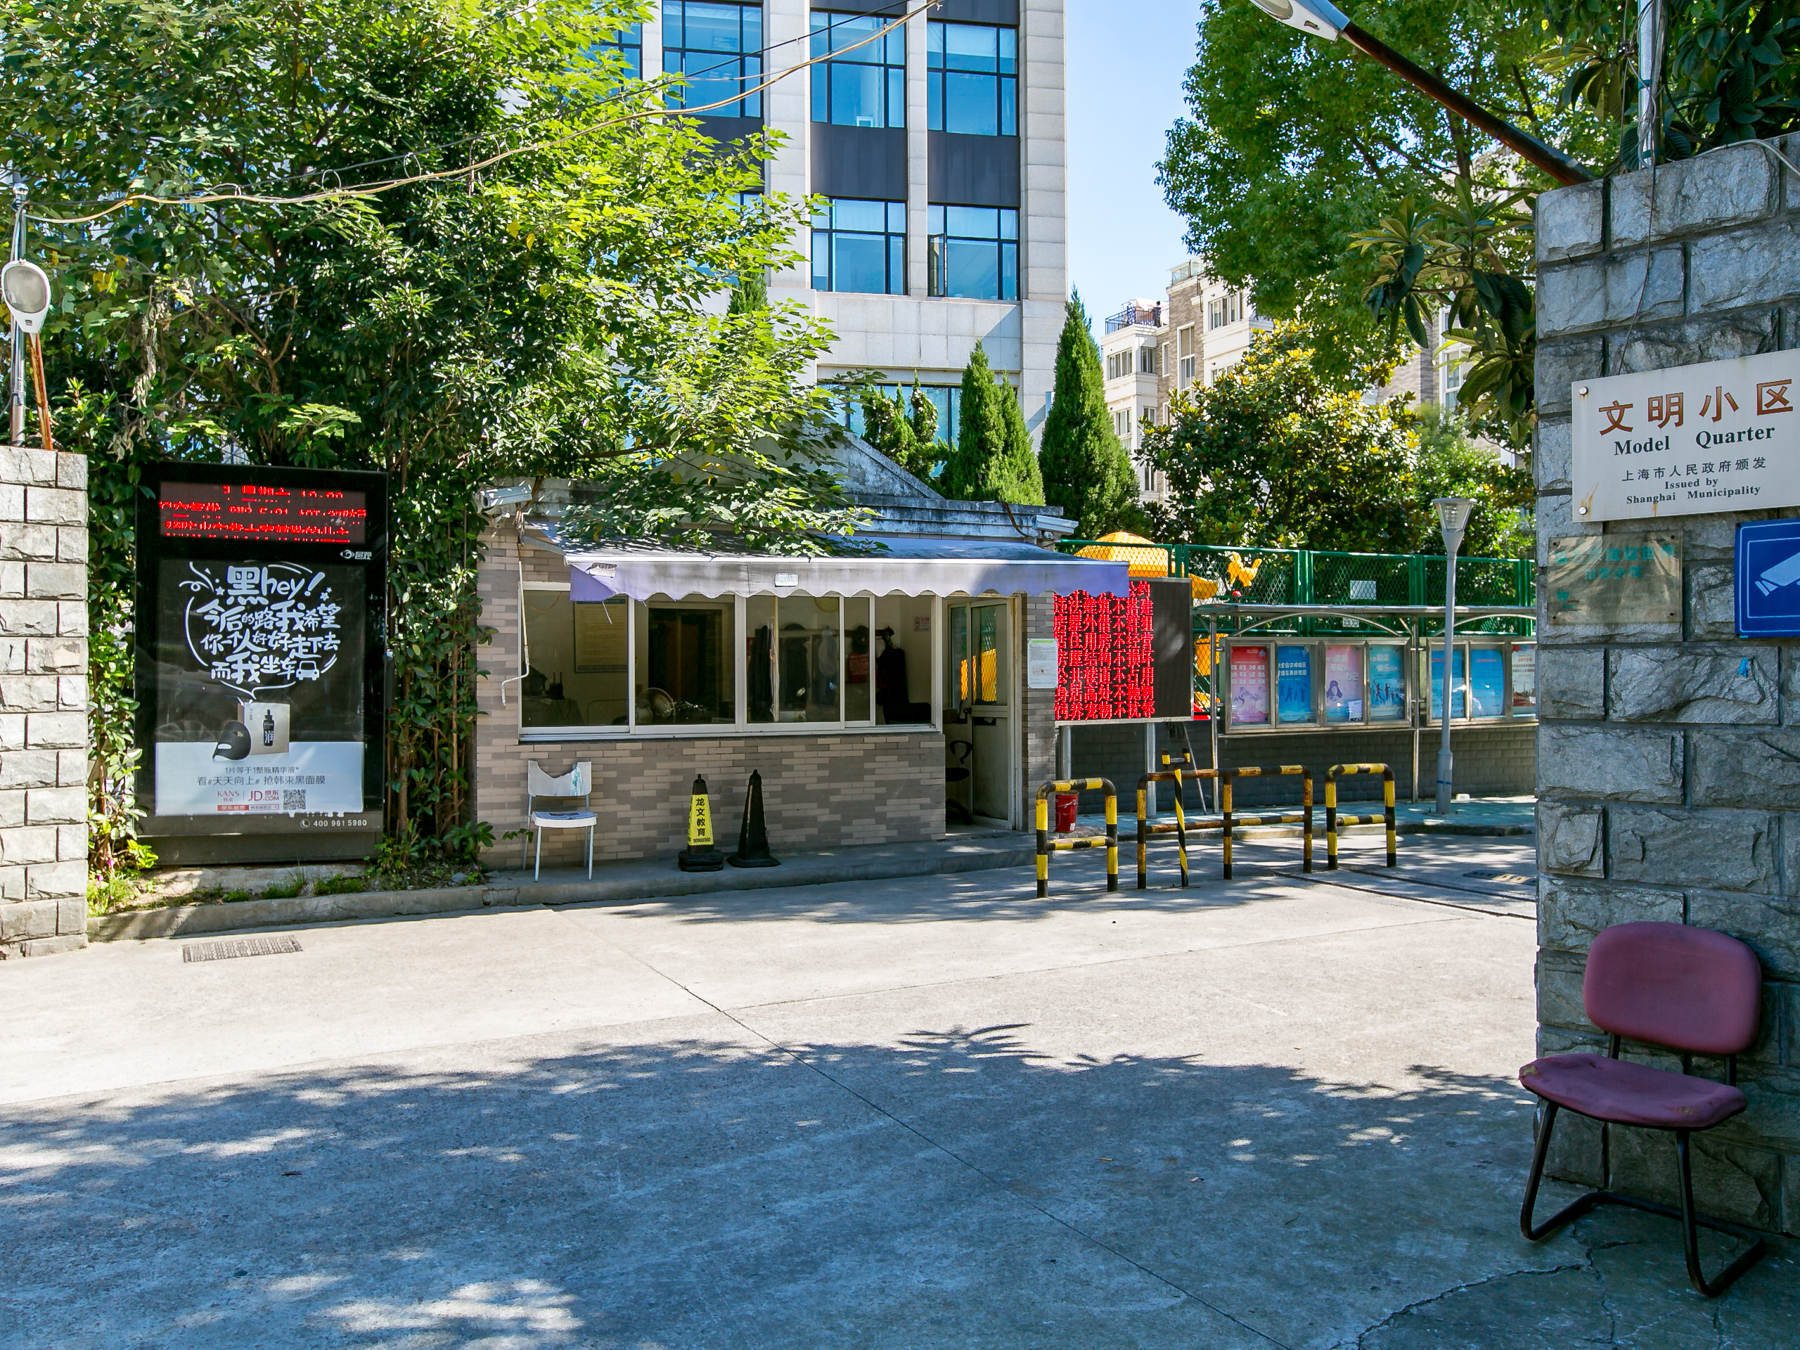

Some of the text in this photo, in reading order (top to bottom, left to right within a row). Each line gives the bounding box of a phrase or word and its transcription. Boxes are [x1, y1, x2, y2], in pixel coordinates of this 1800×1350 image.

[1598, 378, 1794, 436] 文明小区
[1614, 426, 1776, 456] Model Quarter
[1621, 456, 1767, 482] 上海市人民政府颁发
[1664, 477, 1719, 490] Issued by
[1626, 485, 1762, 504] Shanghai Municipality
[196, 599, 342, 633] 今后的路我希望
[200, 628, 341, 659] 你一个人好好走下去
[210, 650, 297, 685] 而我坐车
[217, 790, 240, 798] KANS
[313, 819, 368, 828] 400 961 5980
[695, 797, 706, 837] 龙文教育
